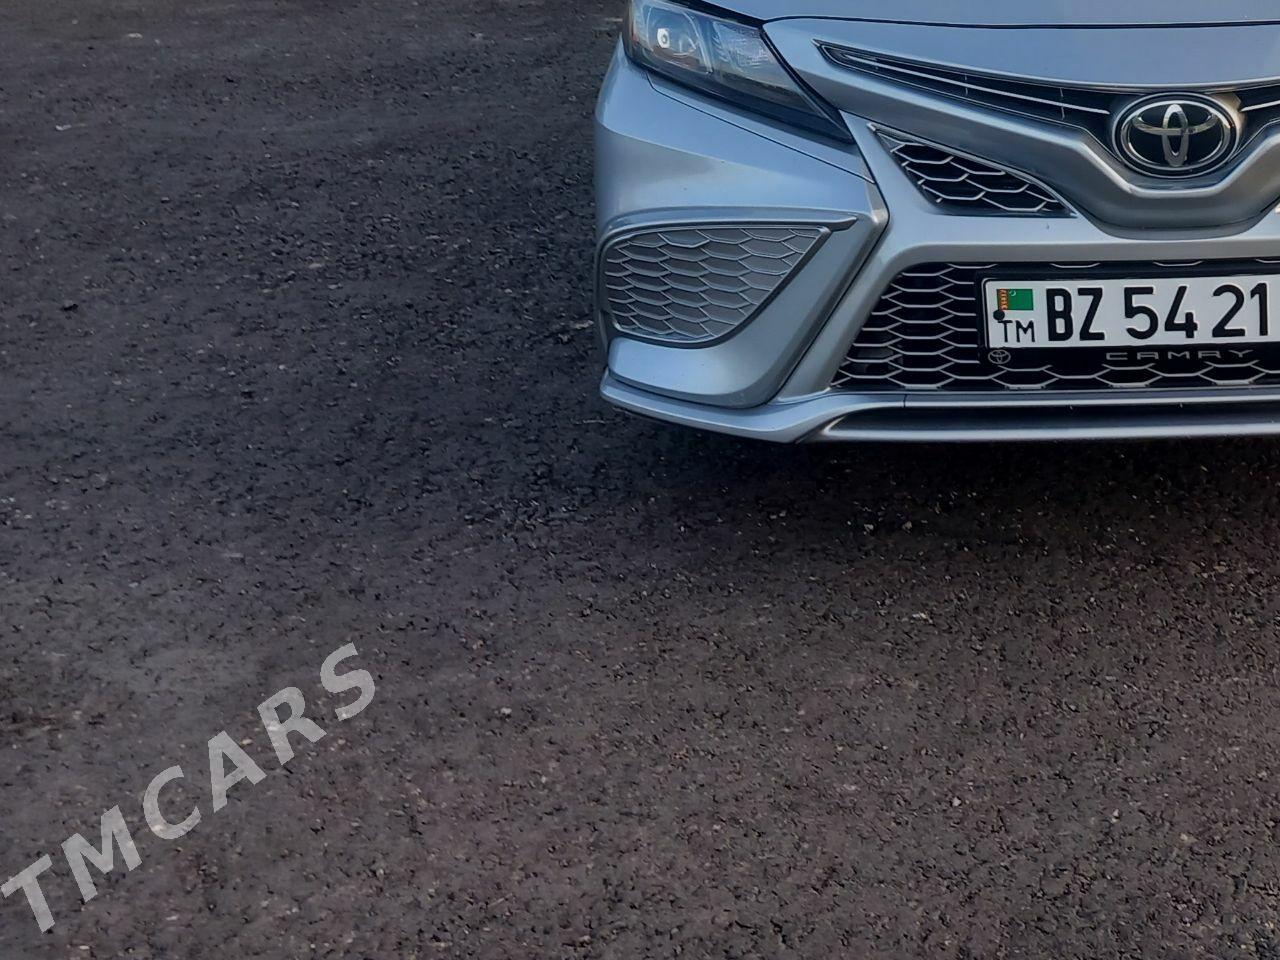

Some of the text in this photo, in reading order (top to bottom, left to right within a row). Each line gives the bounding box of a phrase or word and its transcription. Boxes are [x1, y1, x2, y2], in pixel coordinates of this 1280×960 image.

[1045, 286, 1105, 342] BZ
[999, 319, 1036, 343] TM
[1105, 348, 1254, 361] CAMRY
